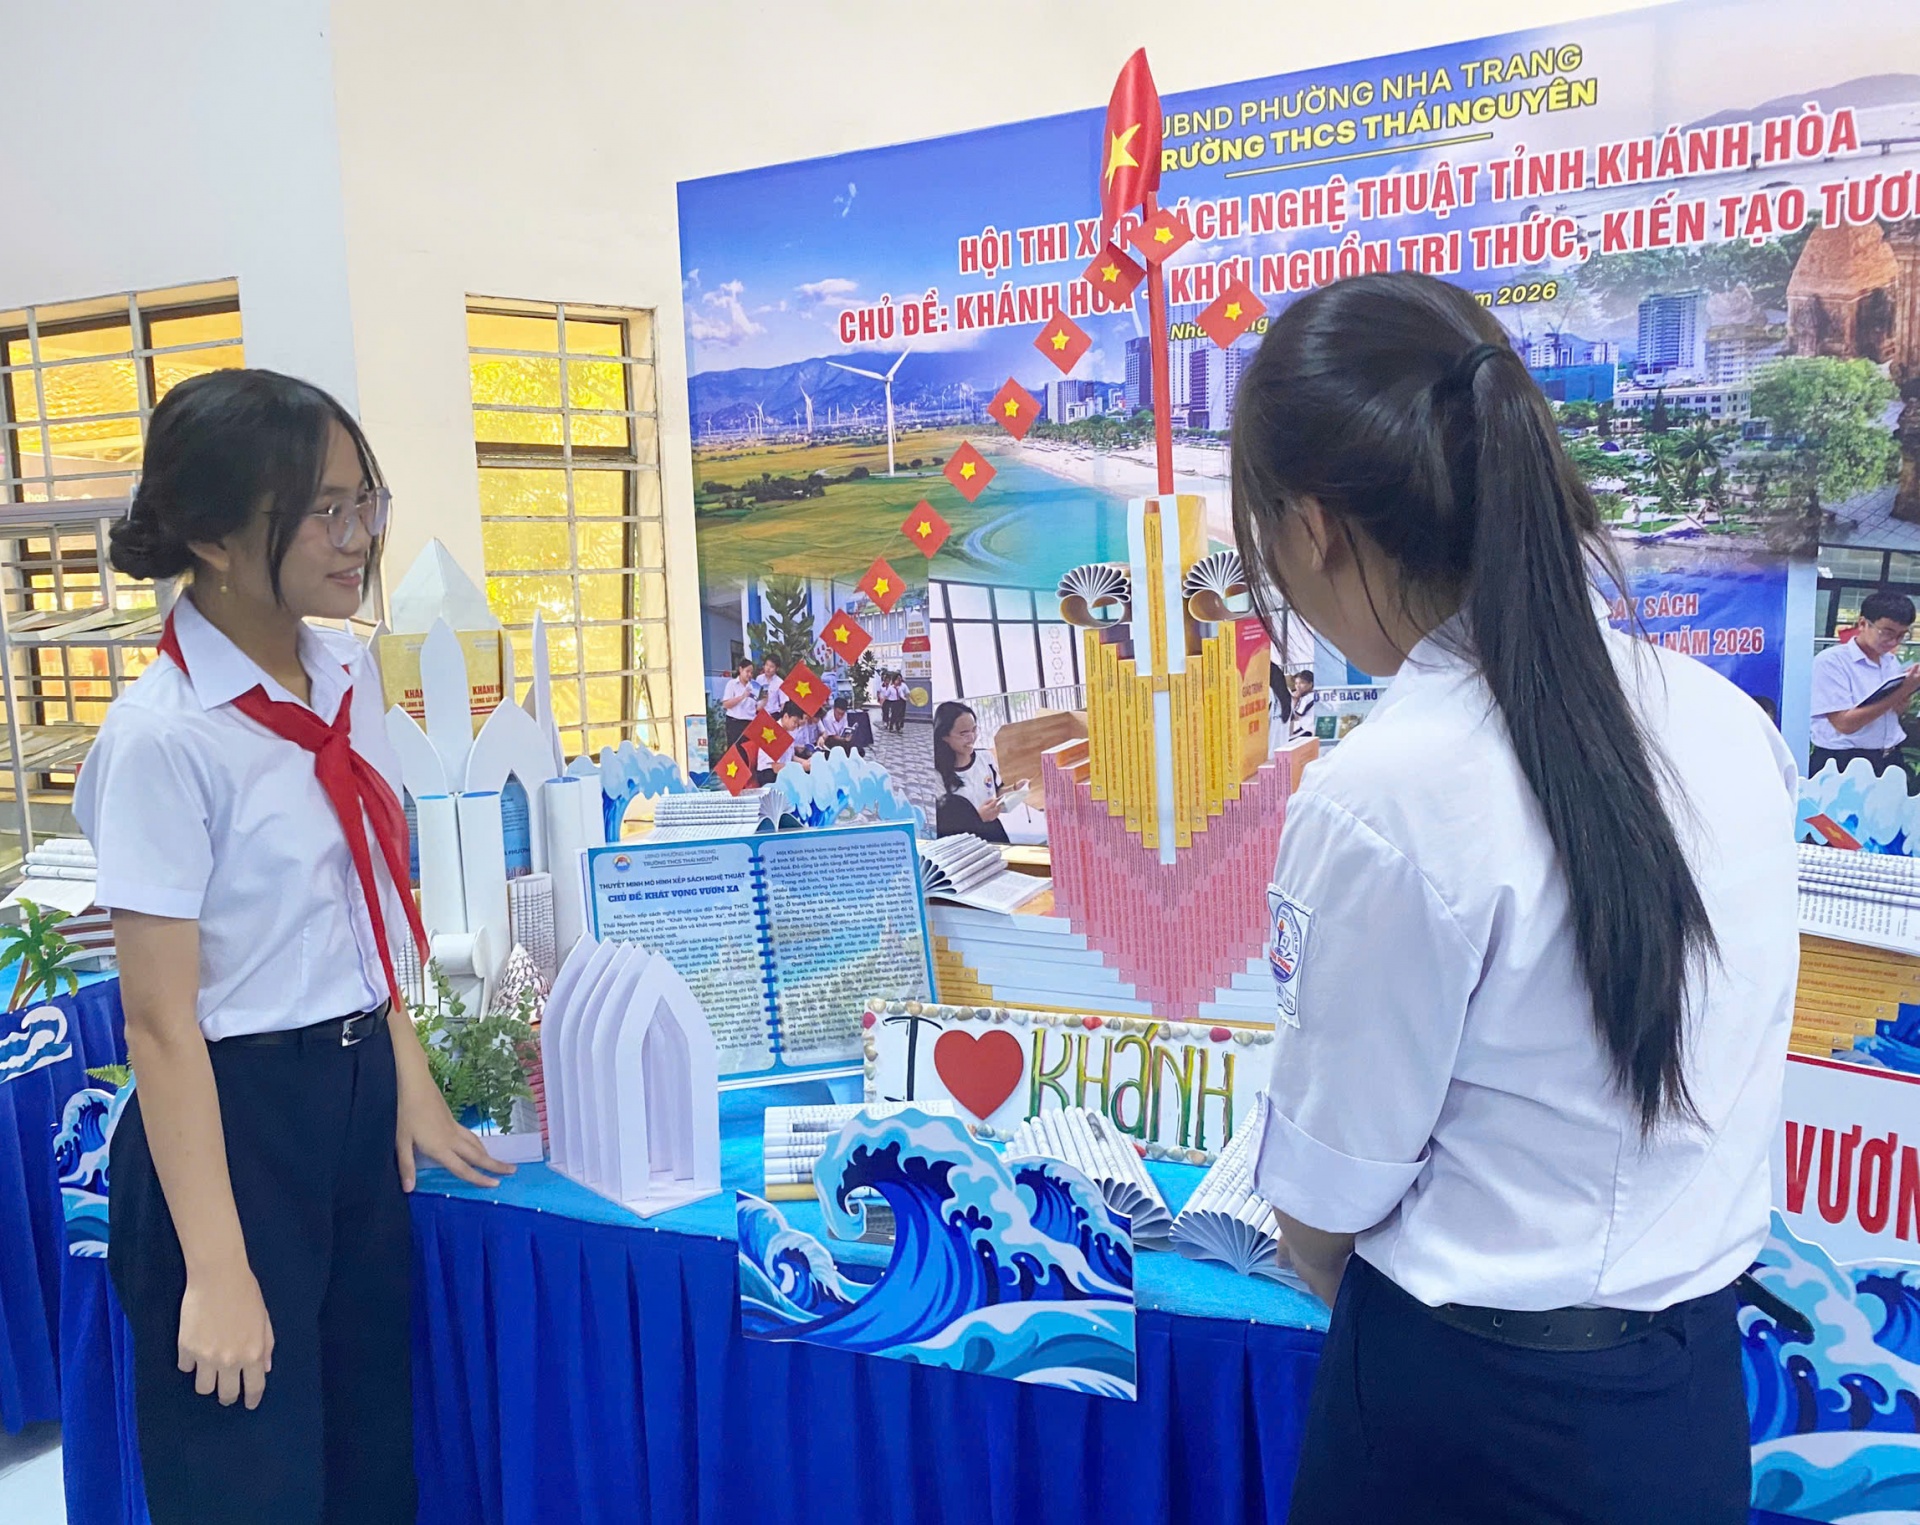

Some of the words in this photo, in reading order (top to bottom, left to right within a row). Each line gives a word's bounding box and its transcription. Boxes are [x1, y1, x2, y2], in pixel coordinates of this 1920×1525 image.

[1161, 134, 1265, 172] RƯỜNG
[1270, 119, 1356, 155] THCS
[1362, 101, 1441, 140] THÁI
[1447, 77, 1597, 127] NGUYÊN
[1240, 81, 1374, 126] PHƯỜNG
[1382, 68, 1453, 102] NHA
[1460, 44, 1582, 88] TRANG
[961, 228, 1011, 277] HỘI
[1019, 225, 1068, 264] THI
[1078, 214, 1138, 256] XP
[1175, 198, 1239, 240] ÁCH
[1250, 178, 1347, 233] NGHỆ
[1358, 163, 1478, 217] THUẬT
[1490, 145, 1583, 200] TỈNH
[1598, 127, 1748, 185] KHÁNH
[1764, 103, 1857, 162] HÒA
[839, 295, 894, 343] CHỦ
[902, 289, 948, 336] ĐỀ:
[957, 283, 1060, 330] KHÁNH
[1262, 233, 1388, 293] NGUỒN
[1400, 232, 1459, 274] TRI
[1472, 214, 1589, 268] THỨC,
[1603, 192, 1705, 252] KIẾN
[1720, 189, 1804, 244] TẠO
[1820, 170, 1920, 226] TƯƠ
[1496, 281, 1557, 306] 2026
[1644, 591, 1698, 618] SÁCH
[1663, 625, 1709, 655] NĂM
[1713, 627, 1764, 655] 2026
[607, 891, 627, 902] CHỦ
[644, 889, 670, 899] KHÁT
[670, 888, 697, 898] VỌNG
[698, 885, 725, 895] VƯƠN
[726, 884, 739, 892] XA
[883, 1015, 943, 1102] I
